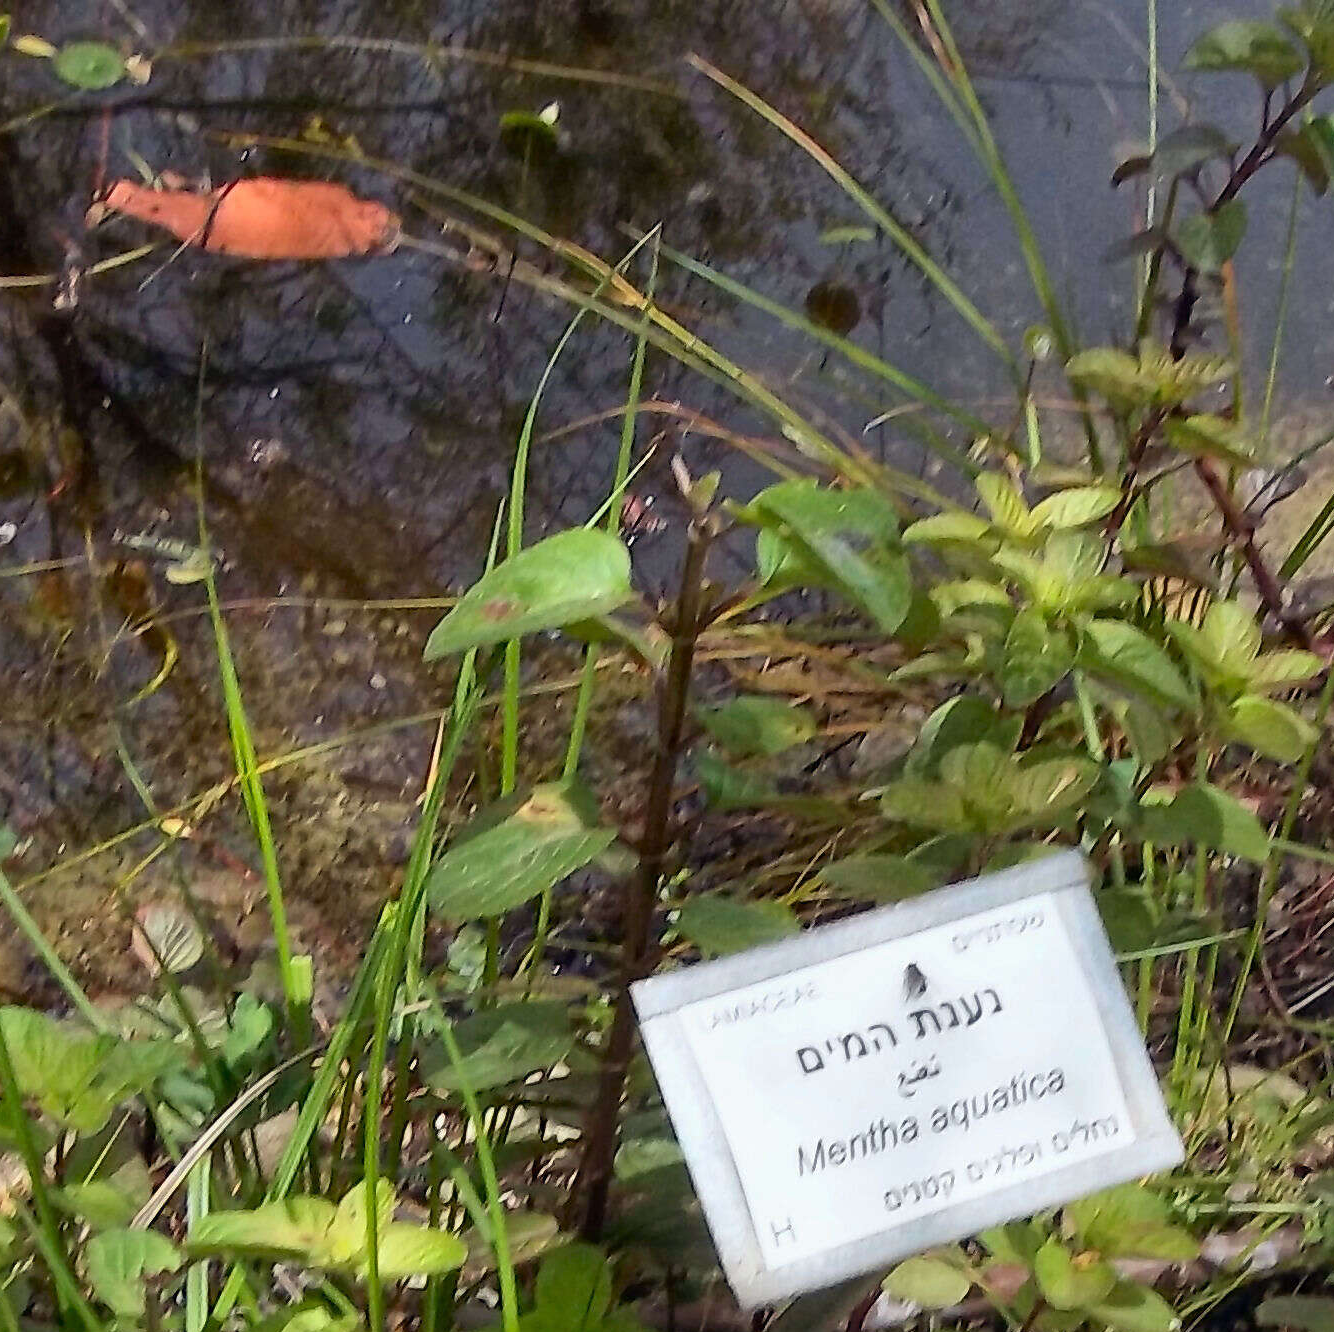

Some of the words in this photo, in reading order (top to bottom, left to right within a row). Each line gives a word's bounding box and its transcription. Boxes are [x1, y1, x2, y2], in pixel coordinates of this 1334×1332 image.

[907, 987, 1004, 1040] נענת
[796, 1022, 899, 1075] המים
[797, 1114, 920, 1177] Mentha
[930, 1066, 1067, 1132] aquatica
[1051, 1113, 1119, 1154] נחלים
[882, 1168, 956, 1212] קטנים
[770, 1216, 796, 1248] H
